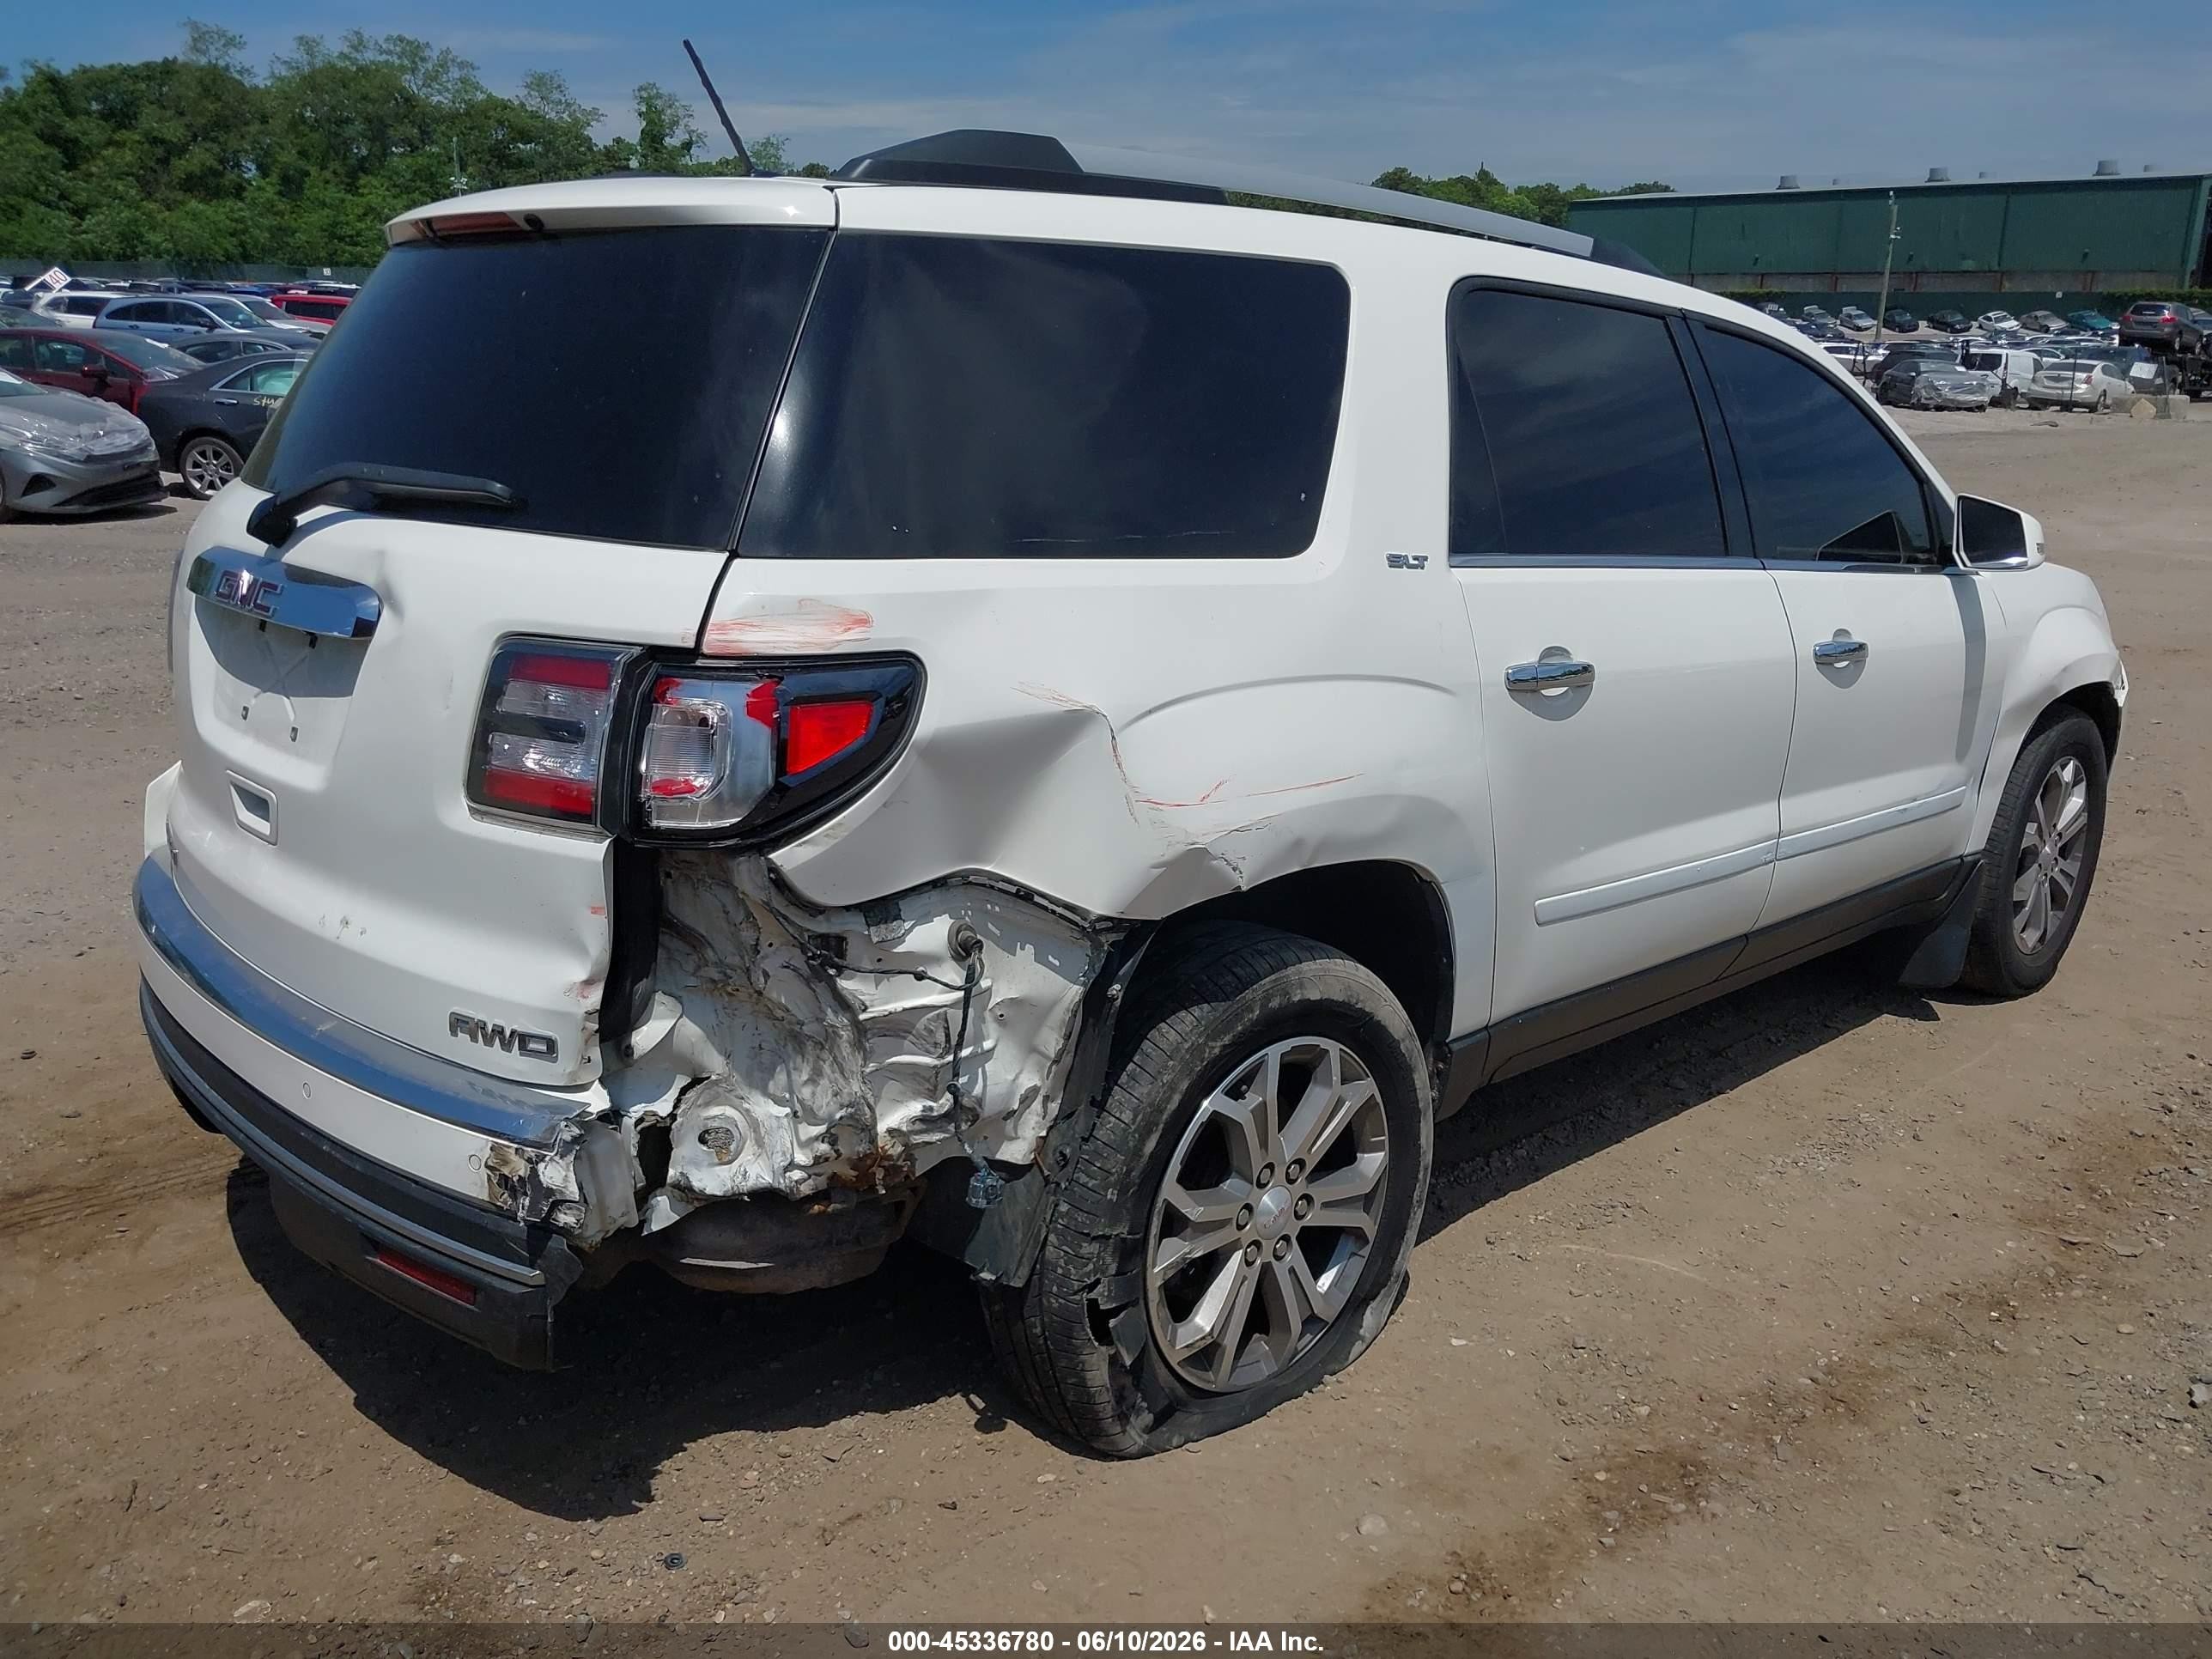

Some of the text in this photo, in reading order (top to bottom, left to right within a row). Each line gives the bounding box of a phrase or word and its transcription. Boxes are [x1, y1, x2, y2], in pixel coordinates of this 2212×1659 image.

[1386, 553, 1429, 570] SLT
[214, 570, 285, 617] GMC
[447, 1008, 560, 1064] AWD
